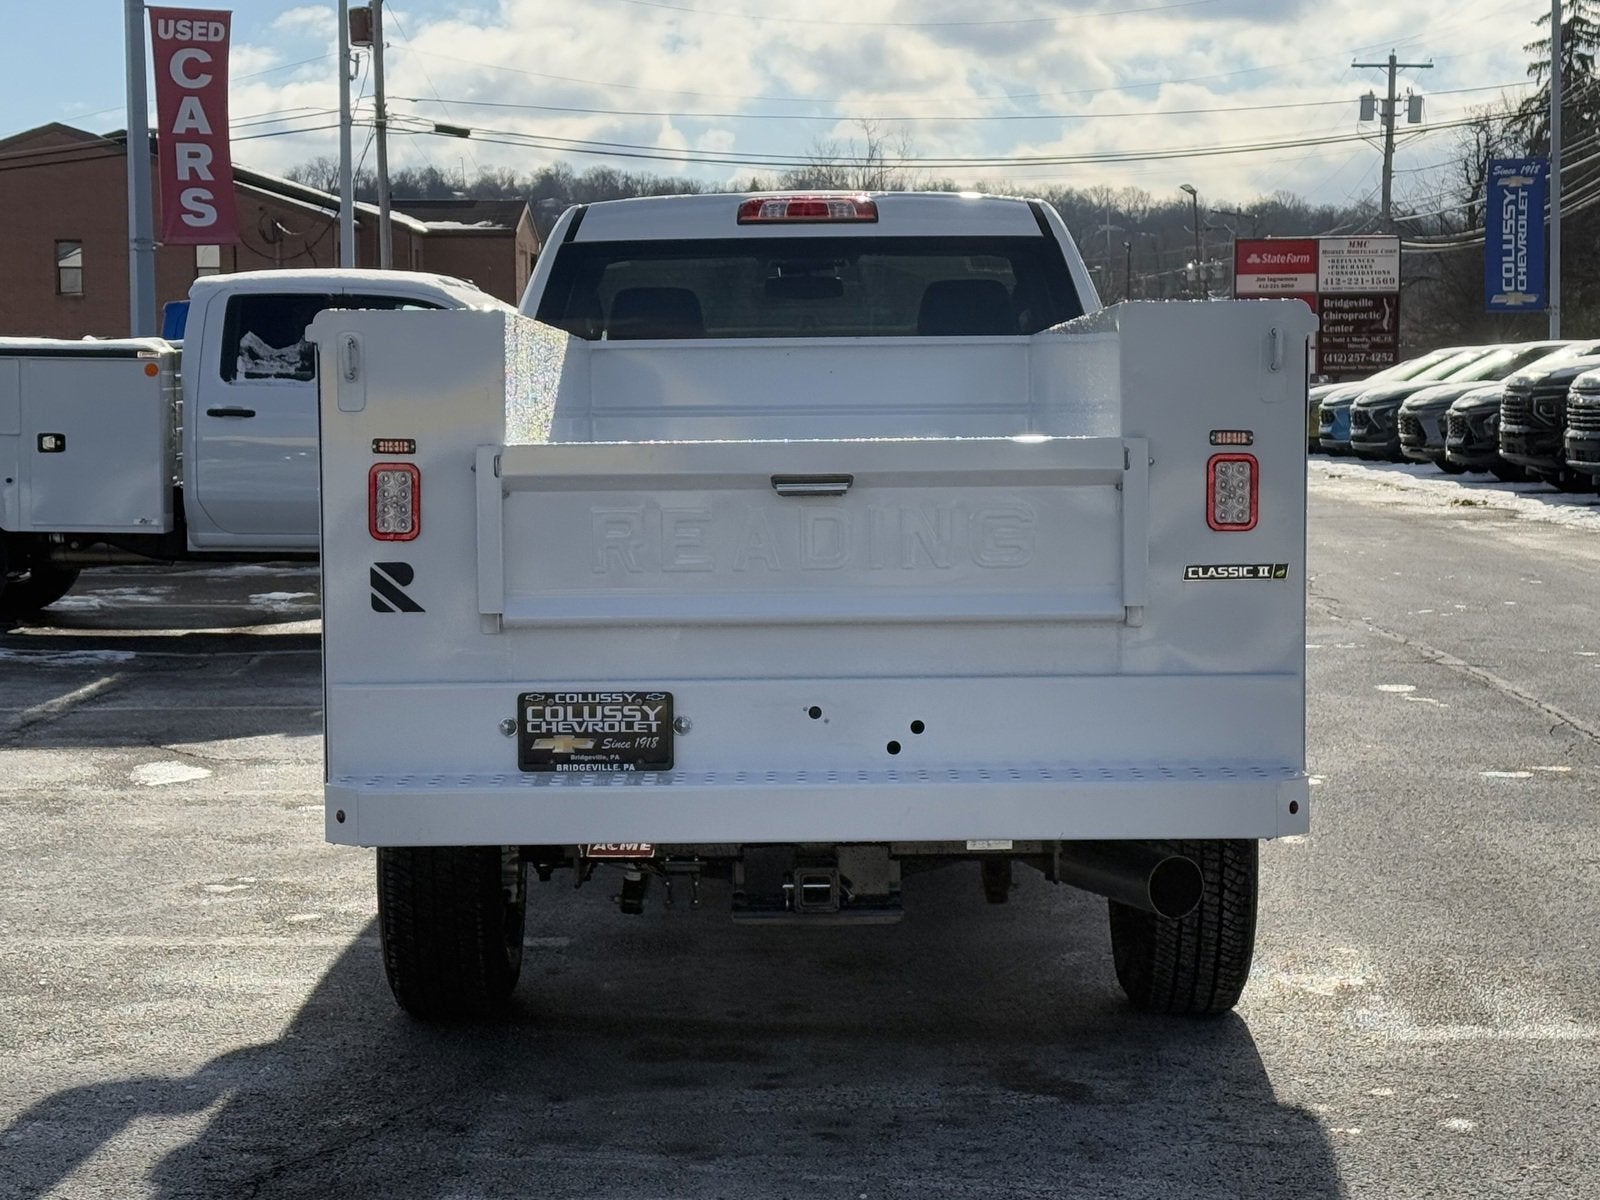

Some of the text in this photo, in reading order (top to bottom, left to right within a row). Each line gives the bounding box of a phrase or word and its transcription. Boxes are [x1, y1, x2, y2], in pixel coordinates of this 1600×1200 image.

[157, 19, 226, 42] USED
[169, 47, 218, 228] CARS
[1492, 164, 1541, 176] Since 1918
[1347, 240, 1370, 249] MMC
[1502, 188, 1517, 292] COLUSSY
[1517, 188, 1528, 291] CHEVROLET
[1323, 298, 1374, 309] Bridgeville
[1322, 310, 1382, 322] Chiropractic
[1322, 324, 1355, 333] Center
[1323, 352, 1394, 364] (412) 257-4252
[590, 503, 1038, 573] READING
[1187, 566, 1271, 578] CLASSIC II
[554, 693, 638, 704] COLUSSY
[526, 705, 663, 722] COLUSSY
[526, 721, 662, 734] CHEVROLET
[601, 737, 660, 750] Since 1918
[570, 754, 609, 762] Bridgeville,
[623, 763, 636, 772] PA
